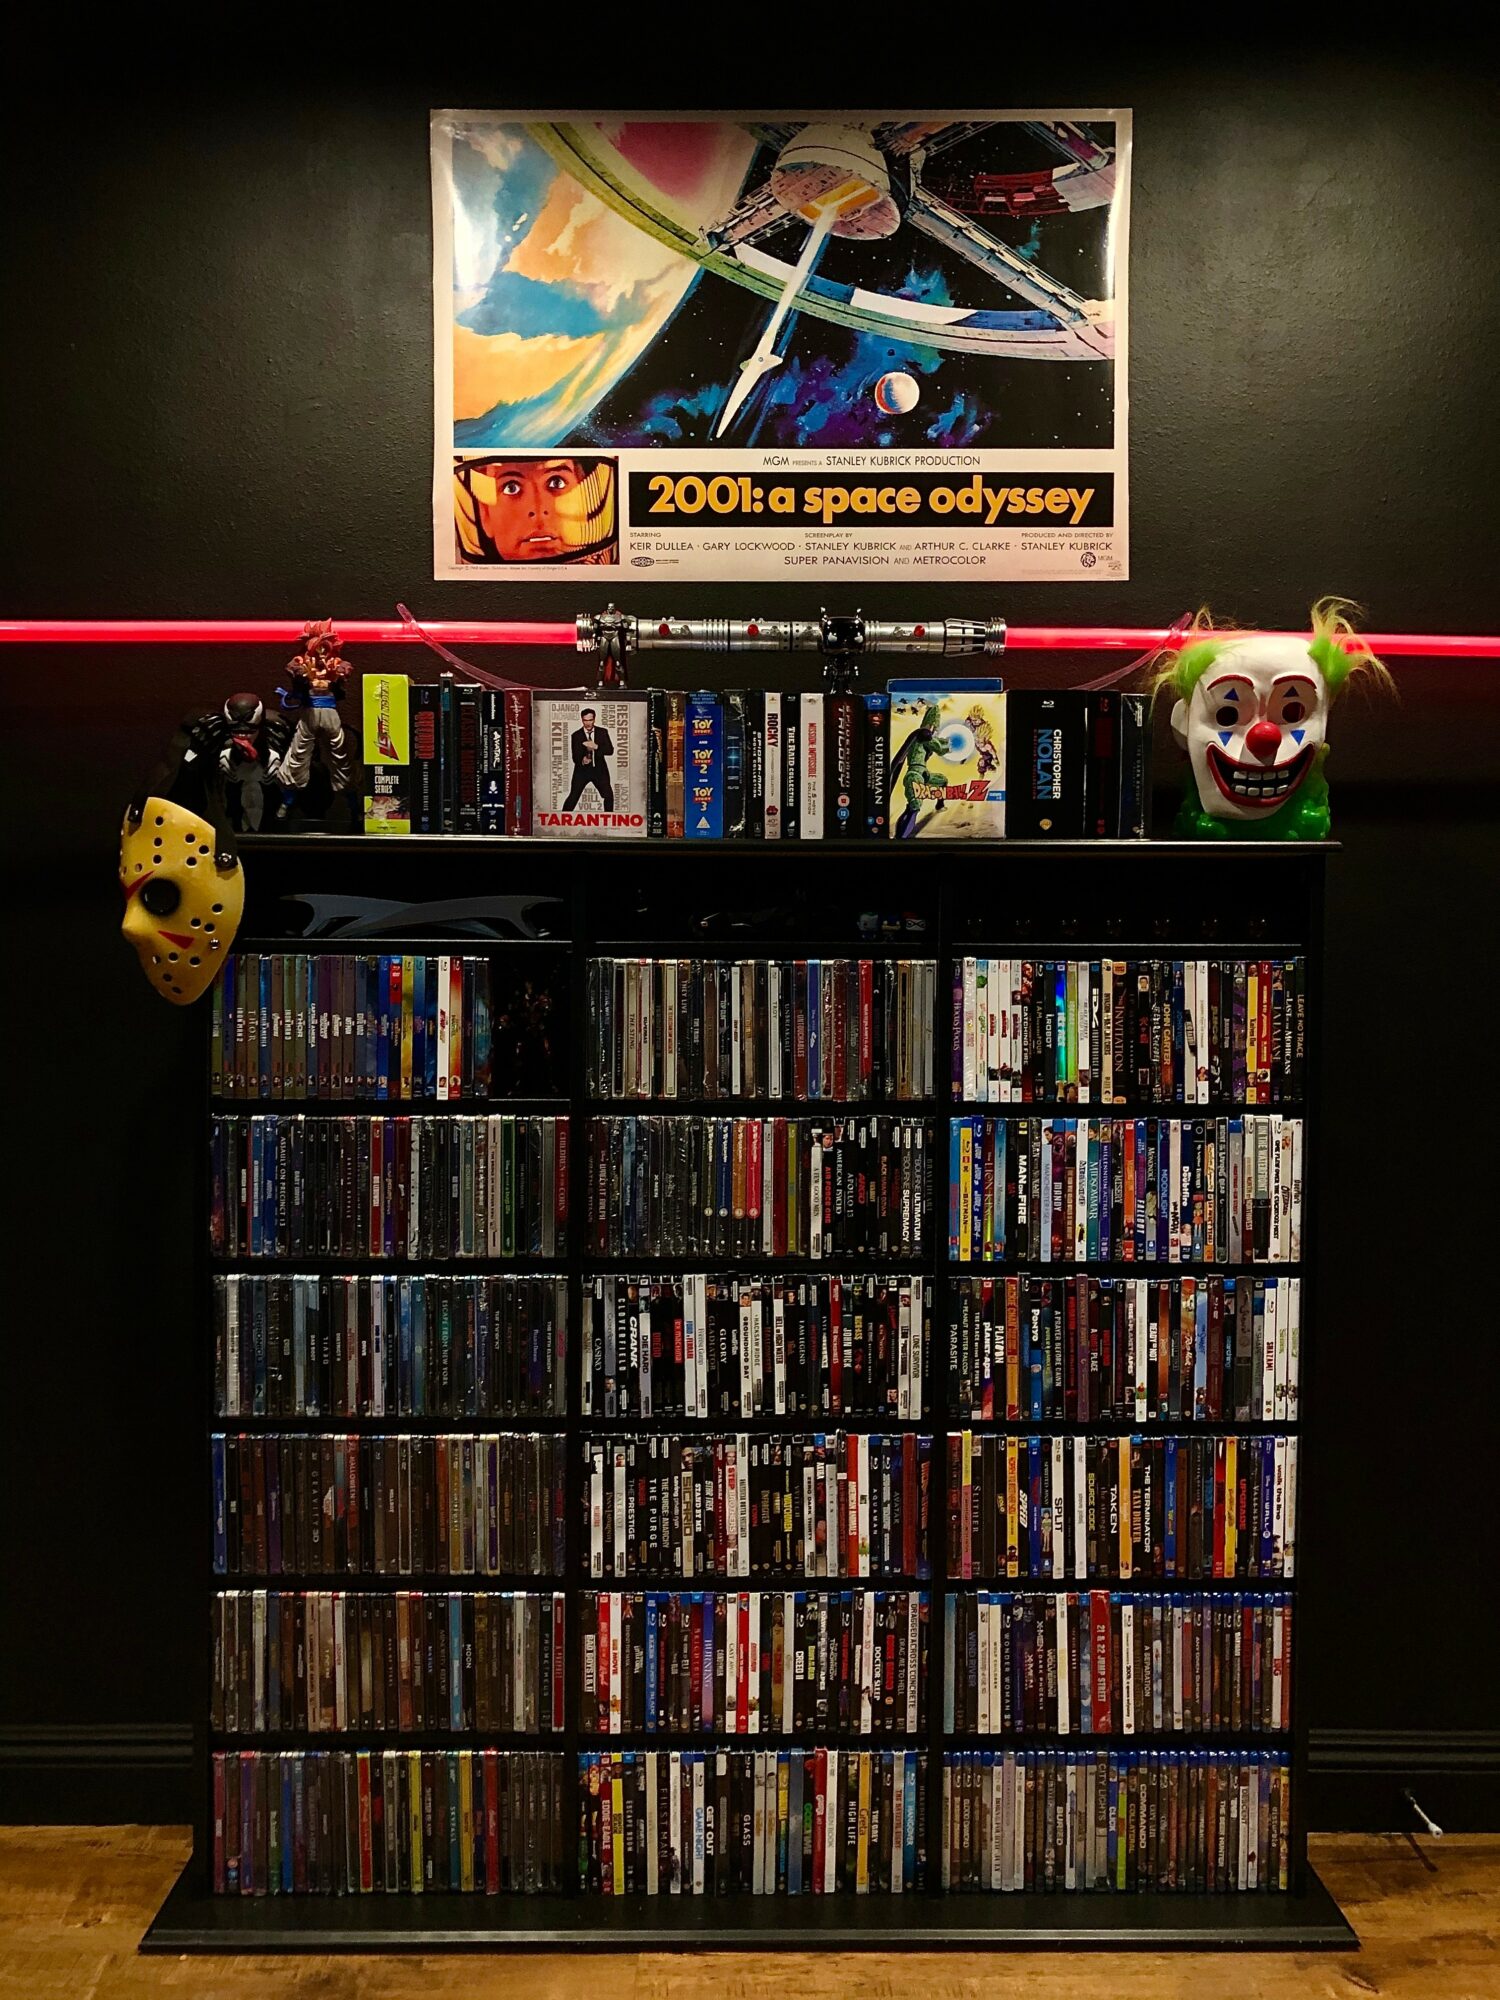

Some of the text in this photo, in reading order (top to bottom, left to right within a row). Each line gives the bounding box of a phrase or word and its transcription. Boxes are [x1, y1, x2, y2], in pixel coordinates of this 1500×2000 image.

[763, 456, 790, 466] MGM
[826, 456, 867, 466] STANLEY
[870, 456, 911, 466] KUBRICK
[914, 455, 981, 466] PRODUCTION
[648, 475, 1095, 525] 2001: a space odyssey
[630, 542, 652, 552] KEIR
[655, 542, 694, 552] DULLEA
[702, 542, 731, 552] GARY
[734, 542, 796, 552] LOCKWOOD
[805, 542, 850, 552] STANLEY
[853, 542, 897, 551] KUBRICK
[915, 542, 956, 551] ARTHUR
[958, 542, 969, 552] C.
[971, 542, 1011, 551] CLARKE
[1020, 542, 1066, 551] STANLEY
[1069, 542, 1113, 551] KUBRICK
[784, 556, 986, 566] SUPER PANAVISION AND METROCOLOR
[551, 703, 580, 712] DJANGO
[608, 704, 616, 729] DEATH
[692, 719, 714, 729] TOY
[616, 704, 629, 769] RESERVOIR
[767, 713, 779, 748] ROCKY
[788, 726, 797, 744] THE
[837, 706, 847, 789] TRILOGY
[374, 766, 385, 775] THE
[692, 749, 714, 759] TOY
[699, 764, 708, 775] 2
[788, 744, 797, 767] RAID
[808, 747, 818, 778] IMPOSSIBLE
[874, 736, 885, 806] SUPERMAN
[1036, 728, 1054, 801] NOLAN
[1052, 728, 1063, 800] CHRISTOPHER
[374, 776, 400, 785] COMPLETE
[374, 785, 394, 794] SERIES
[692, 787, 714, 797] TOY
[581, 794, 601, 803] BILL
[700, 802, 708, 813] 3
[538, 812, 645, 828] TARANTINO
[247, 1009, 256, 1042] THOR
[796, 1014, 805, 1058] UNTOUCHABLES
[1114, 1006, 1125, 1072] INVITATION
[1162, 1002, 1171, 1066] JOHN CARTER
[1296, 994, 1304, 1058] LEAVE NO TRACE
[279, 1136, 287, 1168] ASSAULT
[1018, 1154, 1027, 1185] MAN
[279, 1168, 287, 1181] ON
[1088, 1161, 1099, 1220] MIDSOMMAR
[835, 1188, 843, 1215] PSYCHO
[846, 1172, 854, 1218] APOLLO 13
[901, 1157, 910, 1242] BOURNE SUPREMACY
[1017, 1194, 1026, 1225] FIRE
[1053, 1181, 1062, 1212] MANDY
[1160, 1168, 1168, 1219] MOONLIGHT
[913, 1192, 921, 1241] ULTIMATUM
[1136, 1199, 1145, 1235] FALLOUT
[617, 1297, 626, 1372] CLOVERFIELD
[629, 1315, 638, 1369] CRANK
[1031, 1308, 1040, 1342] PONYO
[593, 1337, 602, 1371] CASINO
[641, 1334, 649, 1374] DIE HARD
[719, 1328, 727, 1364] GLORY
[842, 1327, 852, 1368] JOHN WICK
[912, 1334, 920, 1379] LONE SURVIVOR
[949, 1324, 958, 1371] PARASITE
[994, 1325, 1004, 1364] PLATOON
[1266, 1341, 1274, 1371] SHAZAM!
[311, 1470, 319, 1527] GRAVITY
[682, 1476, 692, 1537] SICARIO
[1087, 1472, 1095, 1507] SOURCE
[627, 1496, 635, 1541] PRESTIGE
[649, 1478, 657, 1549] THE PURGE
[1019, 1489, 1028, 1529] SPEED
[1054, 1497, 1063, 1533] SPLIT
[1110, 1483, 1118, 1534] TAKEN
[1132, 1488, 1141, 1544] TAXI DRIVER
[1096, 1624, 1105, 1633] 21
[465, 1643, 473, 1669] MOON
[795, 1650, 804, 1673] CREED
[909, 1638, 917, 1669] ACROSS
[1096, 1644, 1106, 1653] 22
[1096, 1655, 1106, 1676] JUMP
[873, 1646, 881, 1701] DOCTOR SLEEP
[908, 1670, 916, 1709] CONCRETE
[1097, 1677, 1106, 1702] STREET
[1097, 1763, 1106, 1822] CITY LIGHTS
[705, 1805, 714, 1856] GET OUT
[742, 1814, 751, 1847] GLASS
[847, 1801, 856, 1846] HIGH LIFE
[858, 1808, 869, 1836] Greta
[1056, 1805, 1064, 1846] BURIED
[1108, 1806, 1116, 1832] CLICK
[1139, 1783, 1147, 1849] COMMANDO
